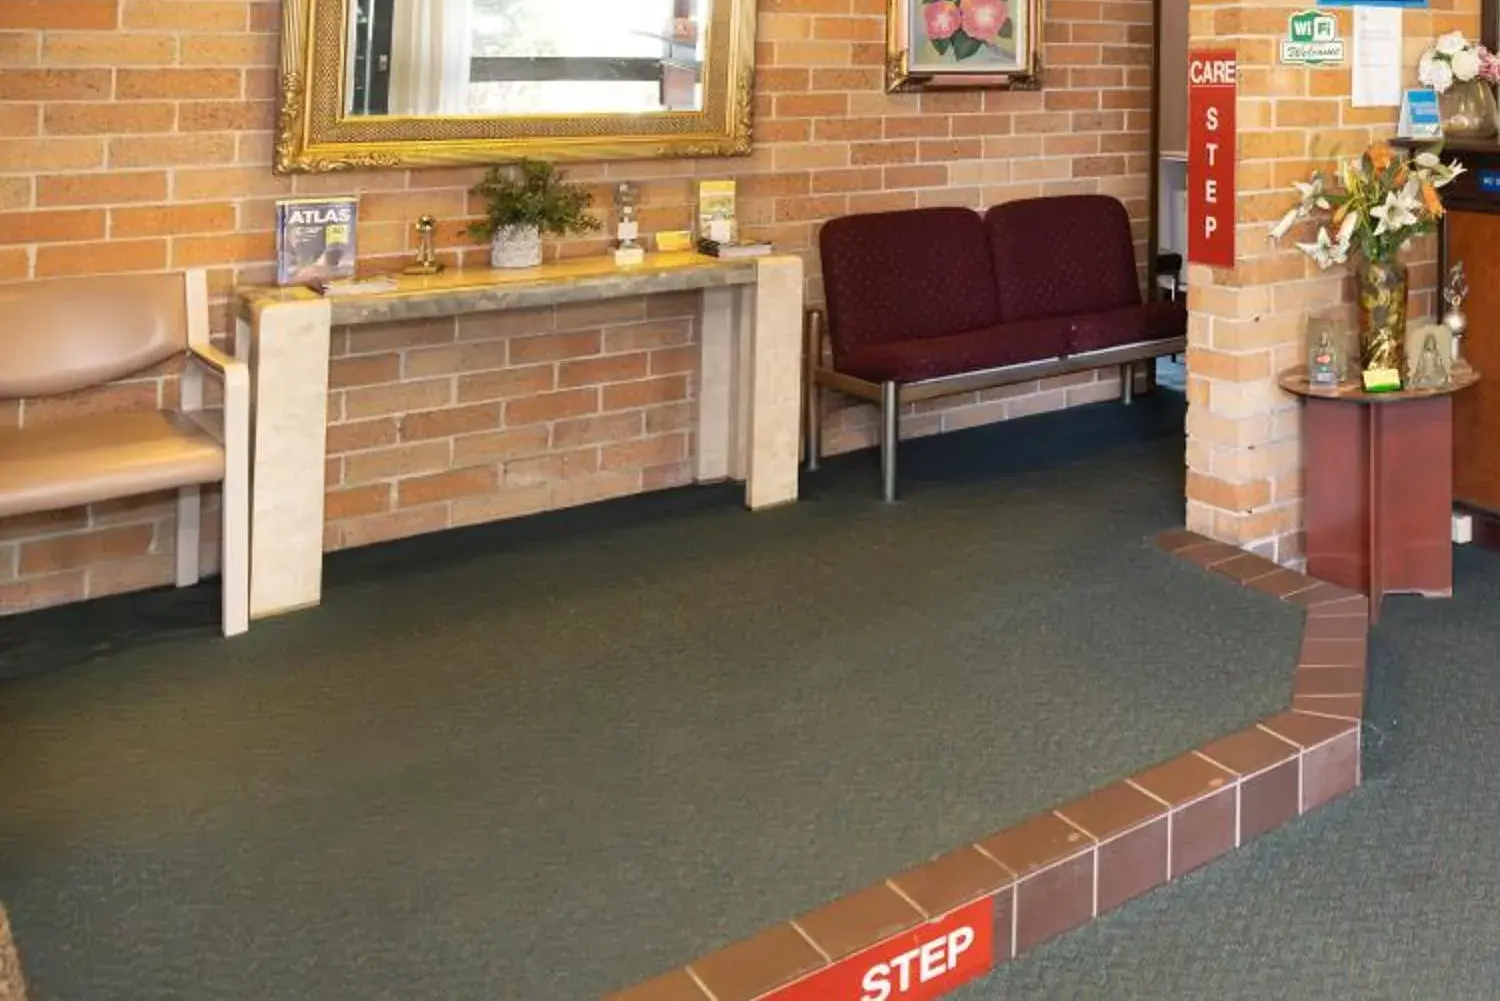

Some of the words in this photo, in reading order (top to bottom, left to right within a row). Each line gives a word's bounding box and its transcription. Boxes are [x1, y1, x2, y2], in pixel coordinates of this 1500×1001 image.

[1190, 60, 1236, 84] CARE
[1204, 106, 1220, 239] STEP
[288, 208, 351, 224] ATLAS
[860, 925, 975, 1001] STEP
